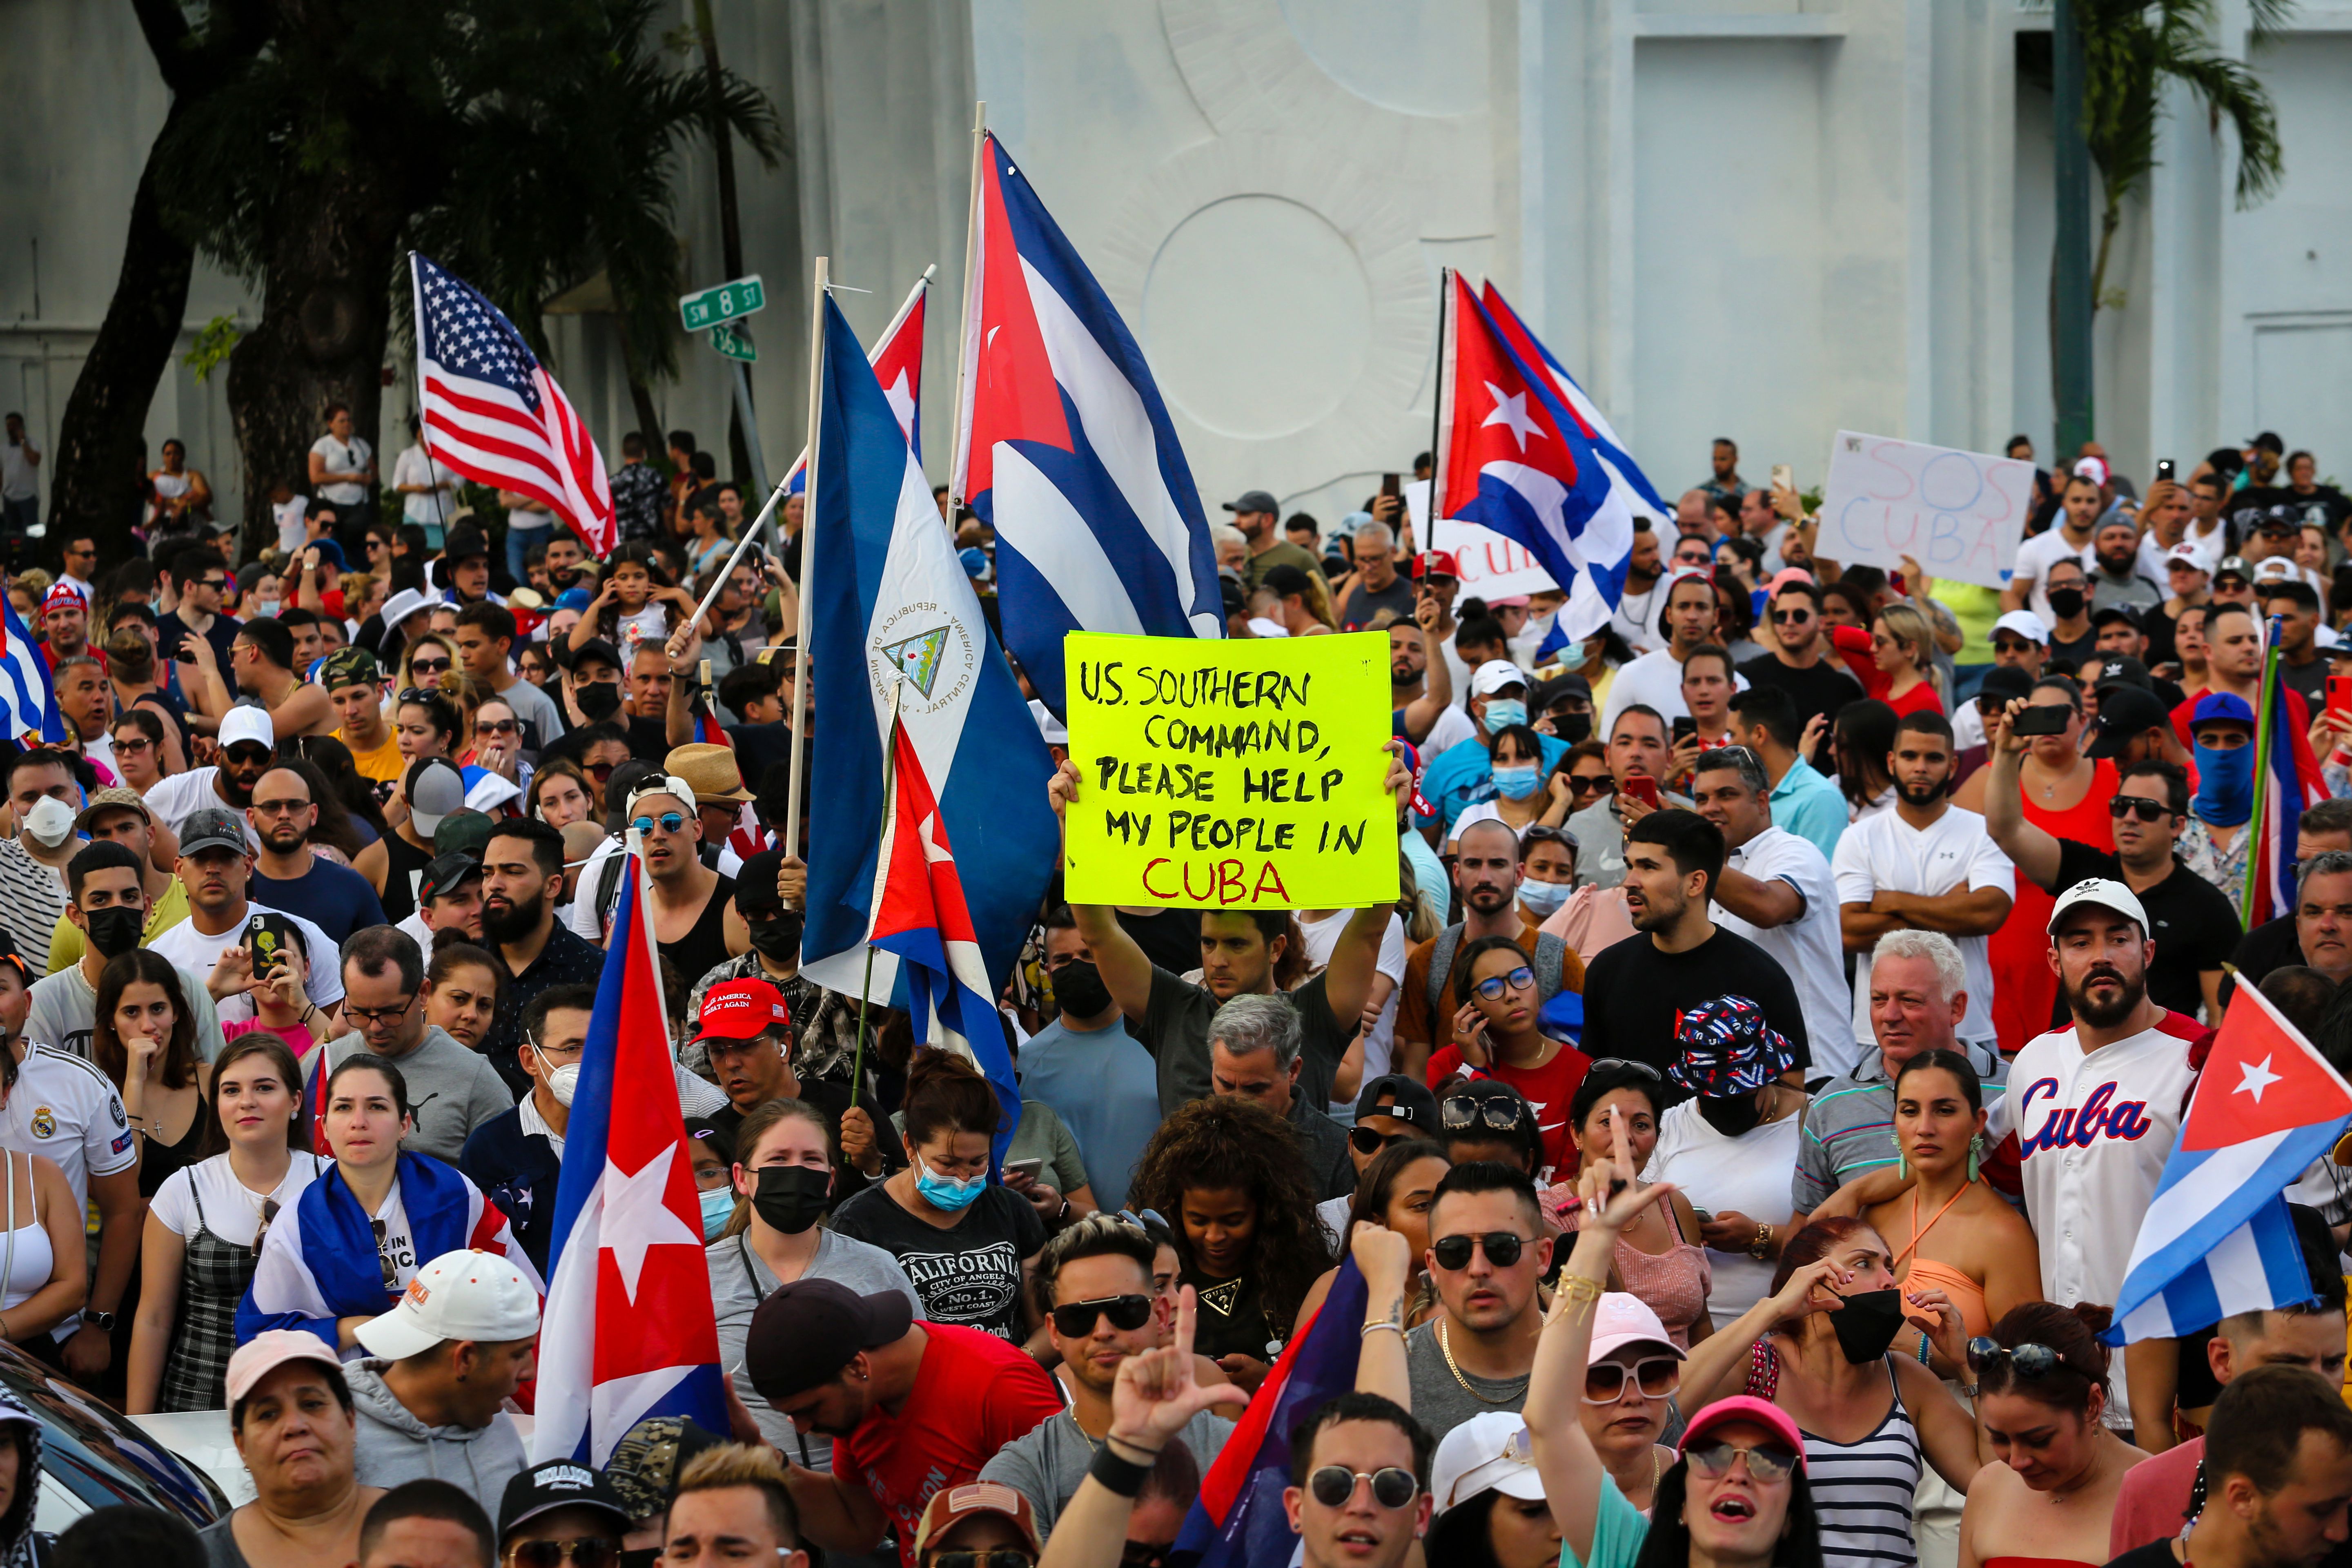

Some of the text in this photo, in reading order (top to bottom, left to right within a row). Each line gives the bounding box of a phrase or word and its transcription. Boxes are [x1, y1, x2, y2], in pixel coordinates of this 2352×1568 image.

[690, 287, 756, 323] SW 8 ST
[1869, 441, 2022, 523] SOS
[46, 596, 81, 611] CUBA
[1080, 661, 1311, 710] U.S. SOUTHERN
[1145, 714, 1331, 762] COMMAND,
[1096, 756, 1343, 803] PLEASE HELP
[1106, 808, 1368, 855] MY PEOPLE IN
[1143, 858, 1291, 905] CUBA
[2074, 888, 2099, 898] adidas
[704, 1004, 722, 1016] GREAT
[717, 993, 752, 1002] AMERICA
[2021, 1077, 2152, 1161] Cuba
[391, 1235, 407, 1249] IN
[910, 1253, 1020, 1286] ALIFORNIA
[930, 1278, 951, 1290] CITY
[1205, 1285, 1237, 1298] GUESS
[940, 1301, 996, 1313] WEST COAST
[533, 1465, 594, 1488] MIAMI
